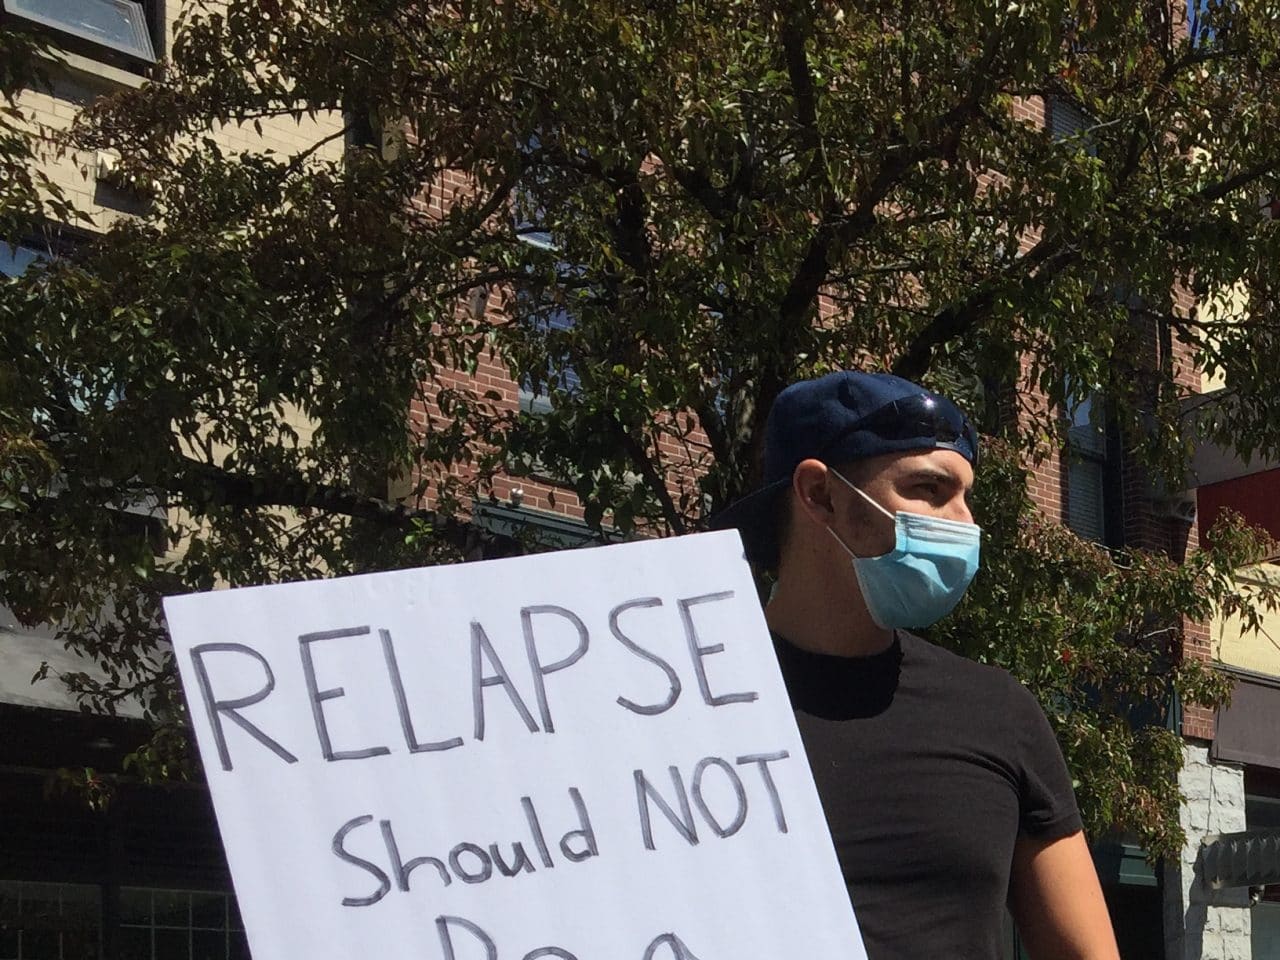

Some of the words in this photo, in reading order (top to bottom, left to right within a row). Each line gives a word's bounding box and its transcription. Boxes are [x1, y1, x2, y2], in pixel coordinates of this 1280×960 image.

[190, 590, 760, 771] RELAPSE
[332, 787, 599, 908] Should
[634, 750, 791, 852] NOT
